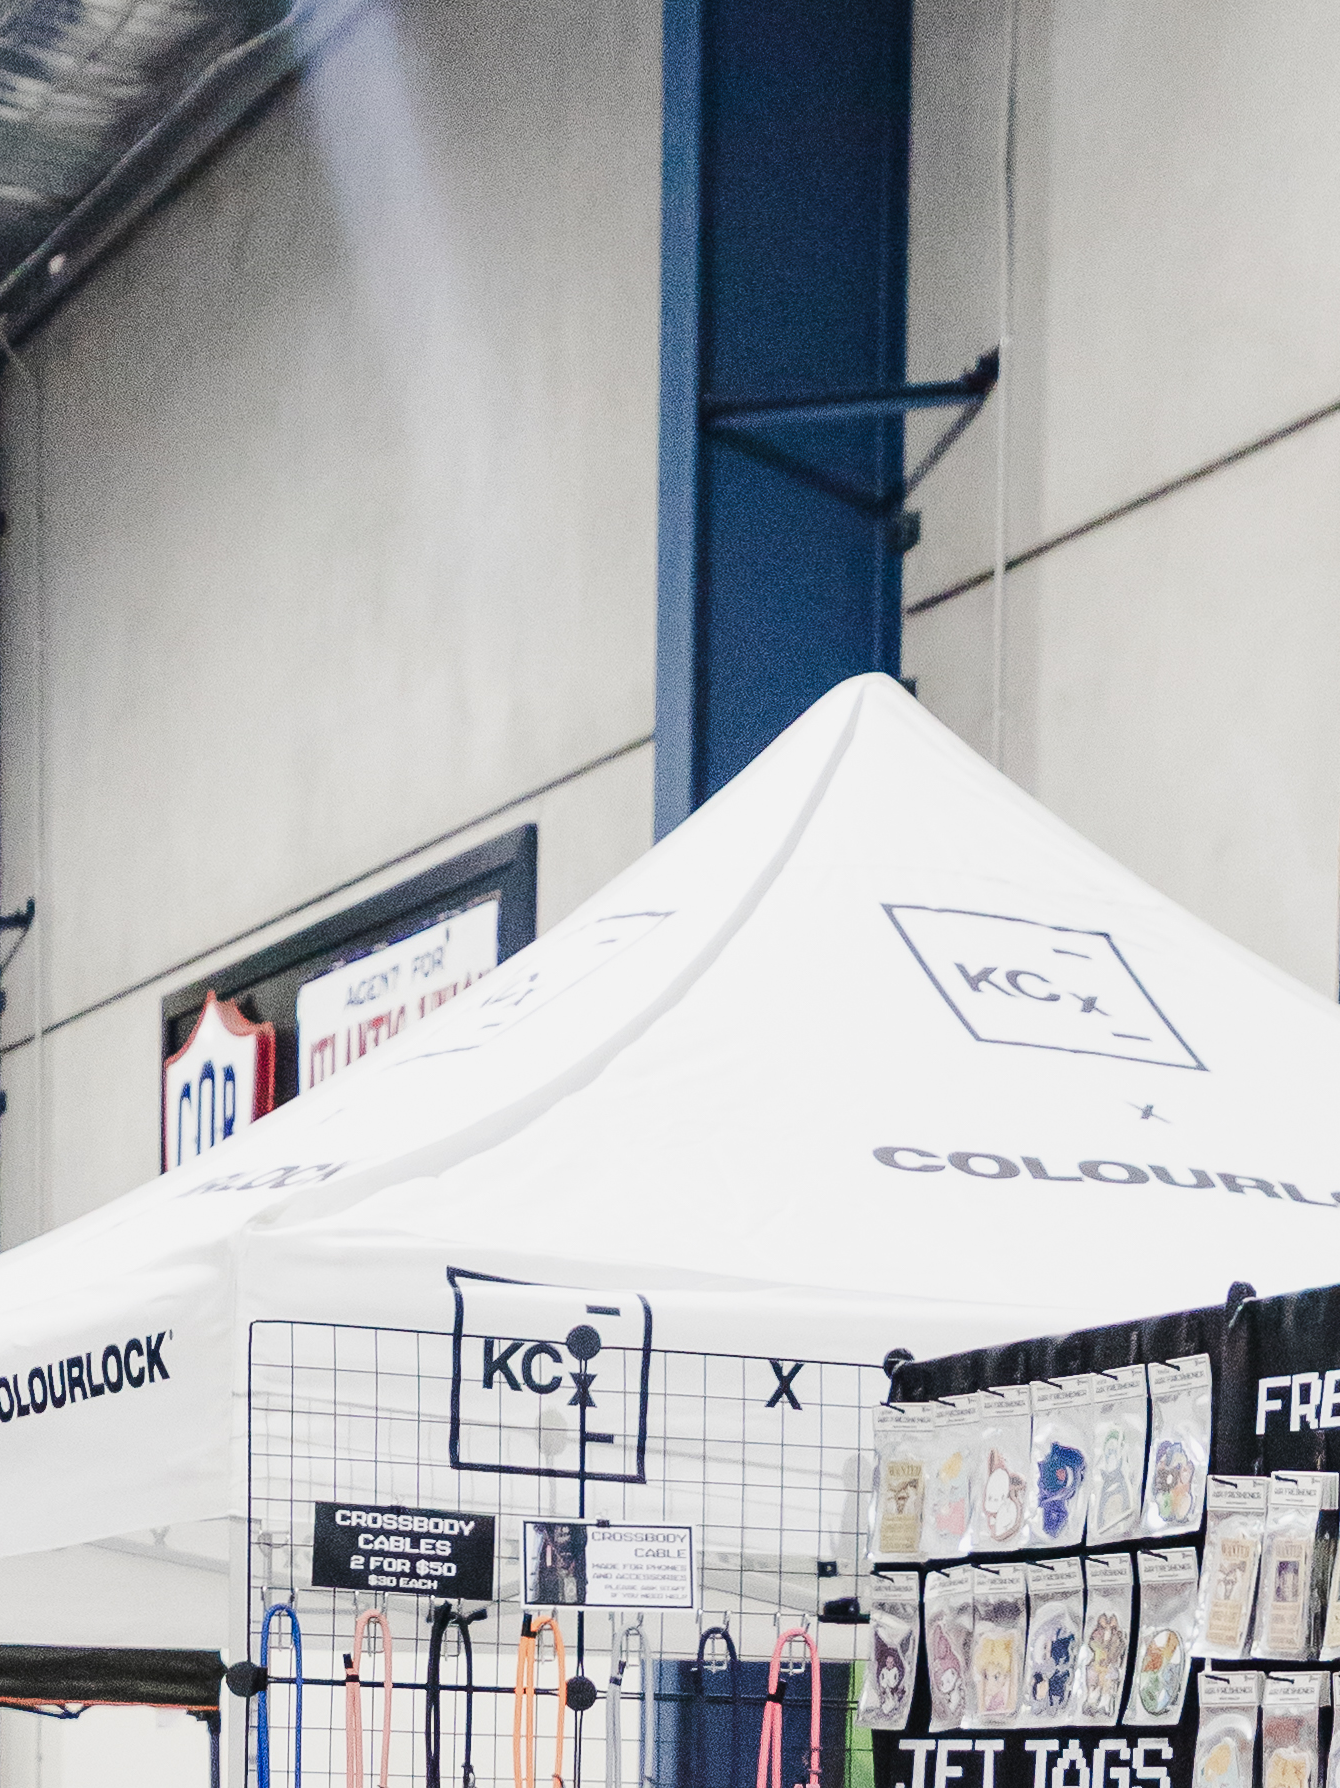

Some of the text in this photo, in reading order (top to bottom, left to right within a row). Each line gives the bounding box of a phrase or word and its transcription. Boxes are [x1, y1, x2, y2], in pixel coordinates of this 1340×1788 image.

[335, 1509, 476, 1536] CROSSBODY
[357, 1533, 452, 1557] CABLES
[591, 1531, 687, 1544] CROSSBODY
[634, 1547, 688, 1559] CABLE
[350, 1555, 457, 1577] 2 FOR $50
[399, 1577, 439, 1591] EACH
